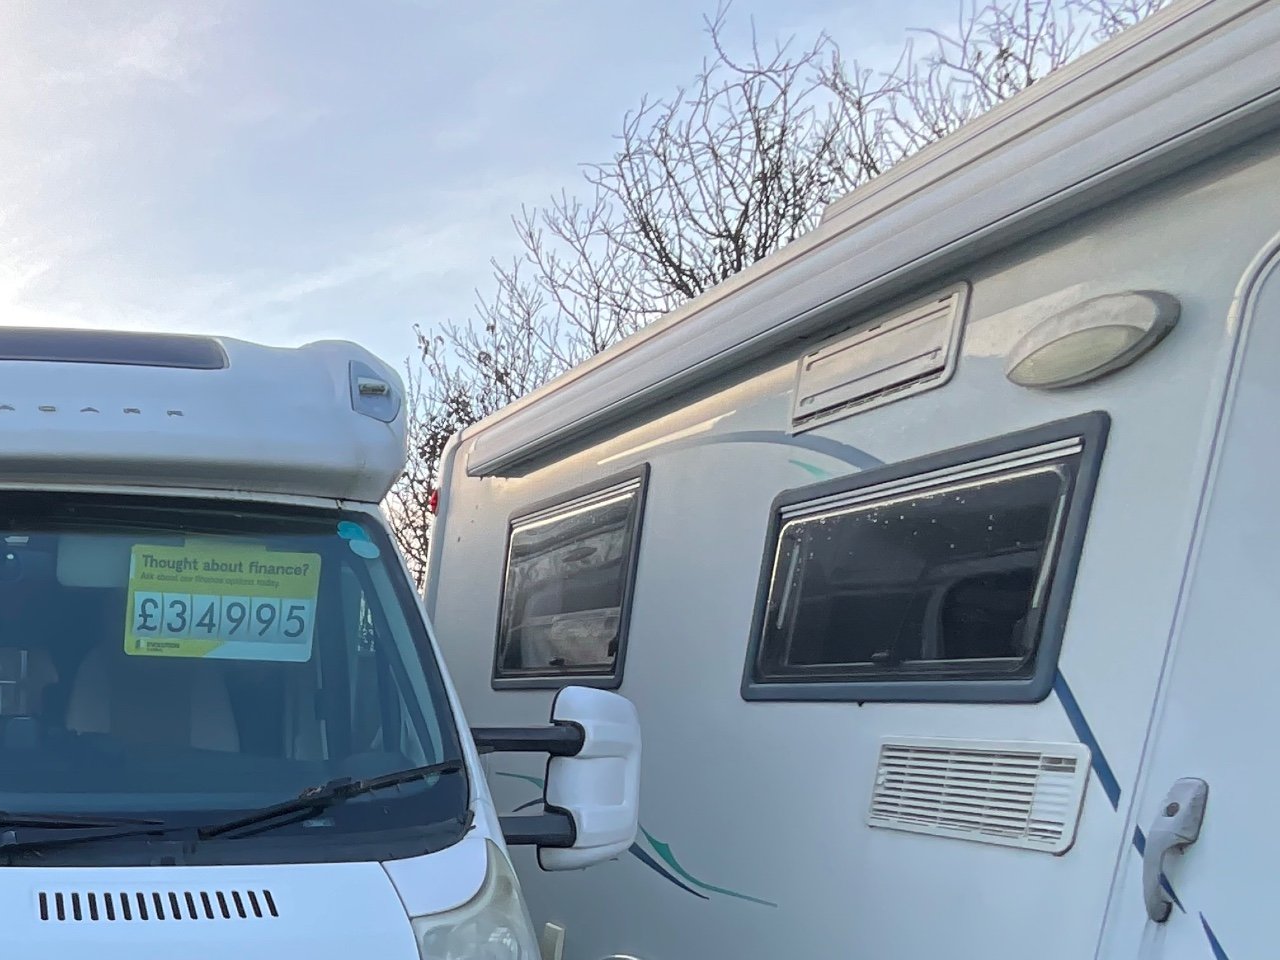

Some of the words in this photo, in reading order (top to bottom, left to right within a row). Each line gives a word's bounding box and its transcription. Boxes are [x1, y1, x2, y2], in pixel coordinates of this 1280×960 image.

[142, 554, 199, 573] Thought
[203, 559, 244, 574] about
[249, 561, 310, 577] finance?
[137, 598, 306, 638] £34995
